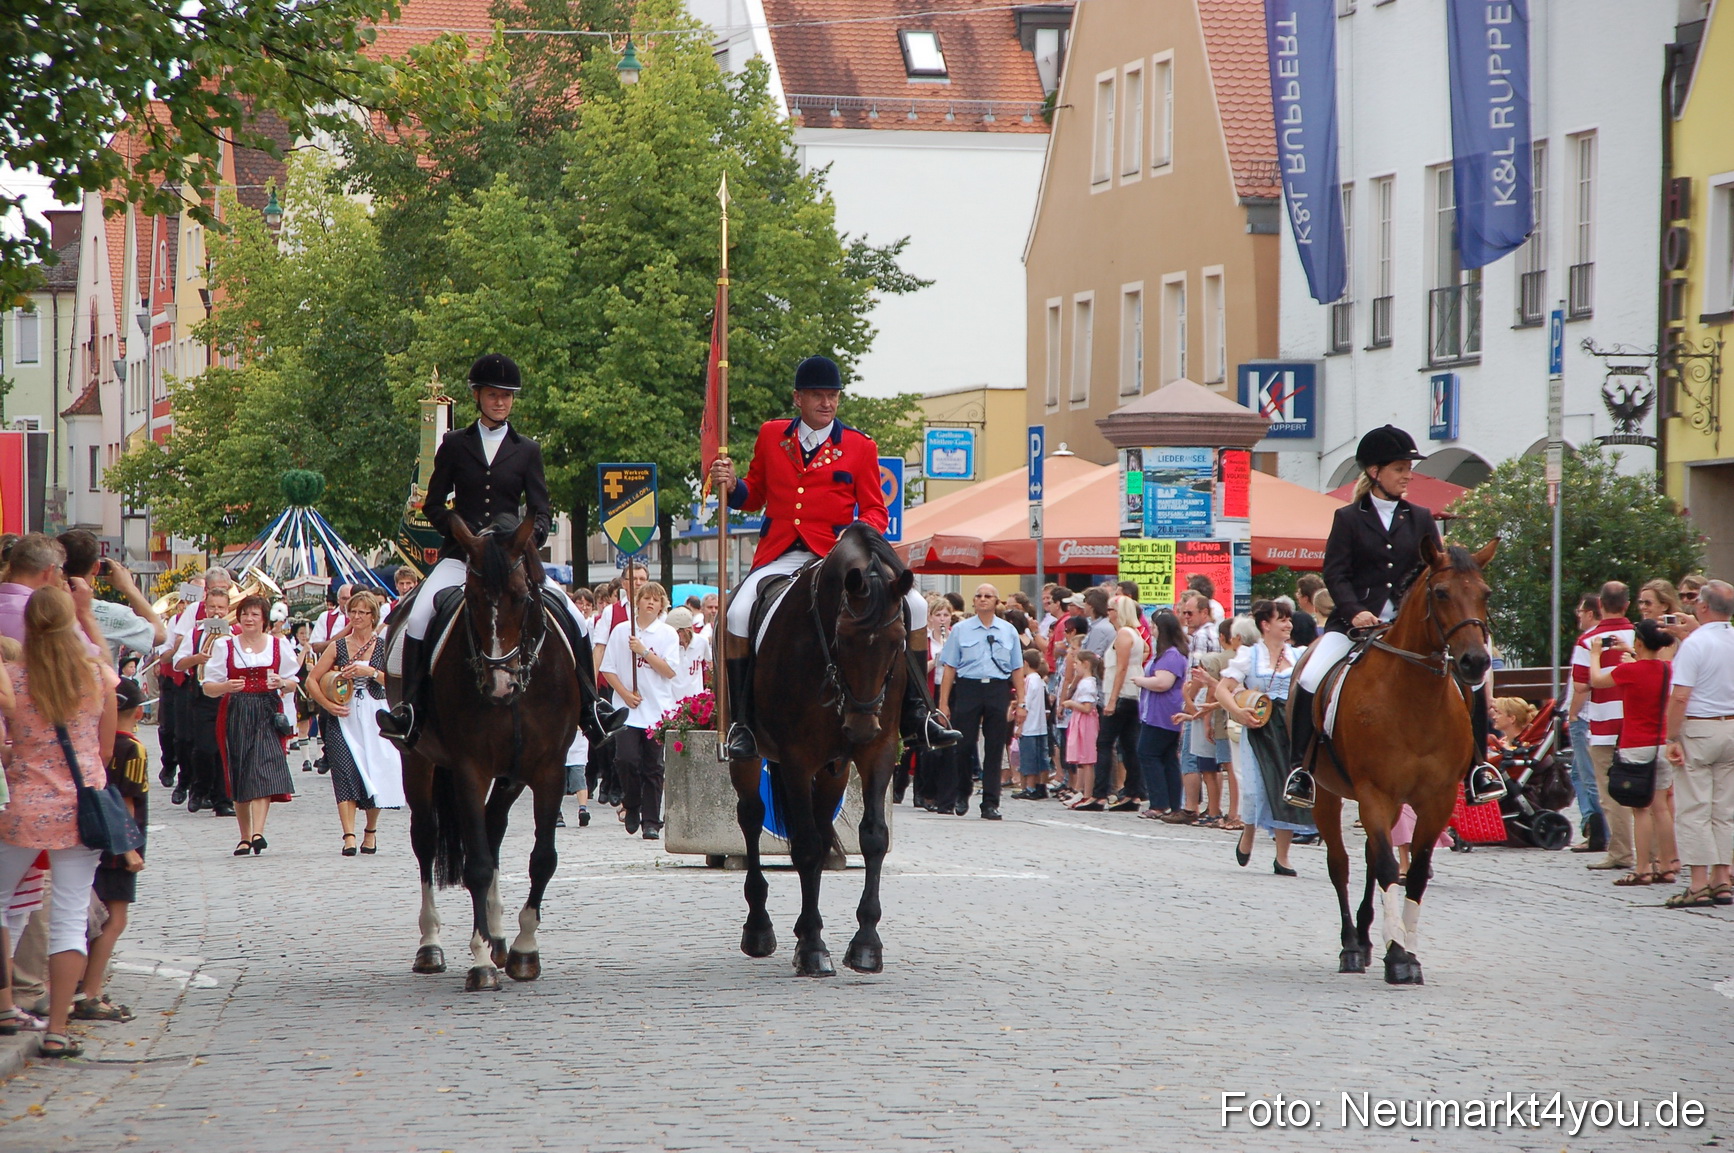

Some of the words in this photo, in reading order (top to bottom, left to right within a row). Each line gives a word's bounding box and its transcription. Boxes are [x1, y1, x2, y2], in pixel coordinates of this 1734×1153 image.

[1486, 0, 1515, 129] RUPPE
[1492, 137, 1517, 206] K&L
[1031, 434, 1042, 476] P
[1058, 539, 1117, 565] Glossner
[1151, 543, 1171, 553] Club
[1187, 541, 1221, 551] Kirwa
[1267, 547, 1298, 559] Hotel
[1175, 552, 1231, 563] Sindlbach
